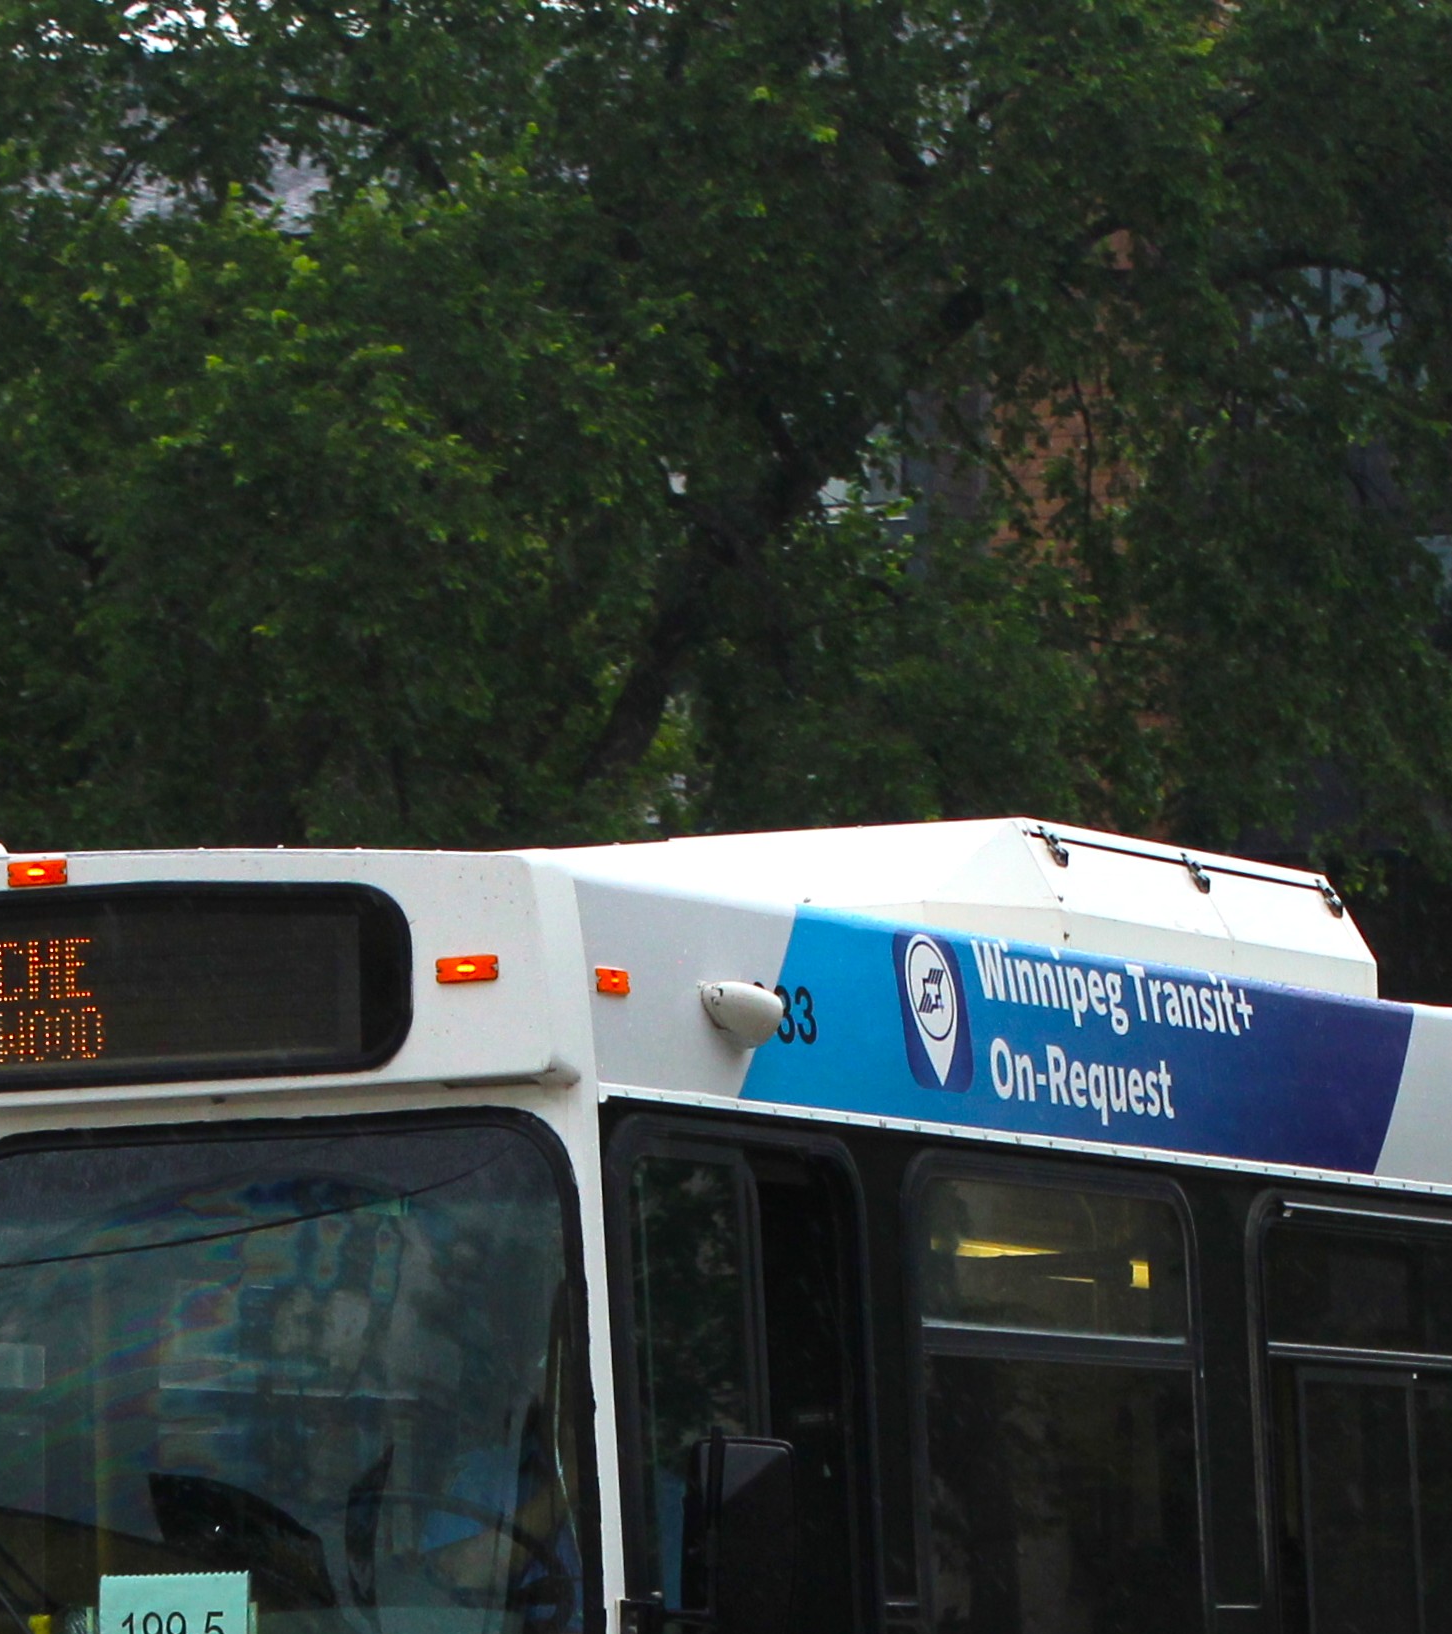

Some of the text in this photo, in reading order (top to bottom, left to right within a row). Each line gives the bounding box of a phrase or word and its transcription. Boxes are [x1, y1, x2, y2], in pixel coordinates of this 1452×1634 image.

[753, 981, 818, 1045] 33
[971, 941, 1254, 1036] Winnipeg Transit+
[990, 1037, 1175, 1126] On-Request
